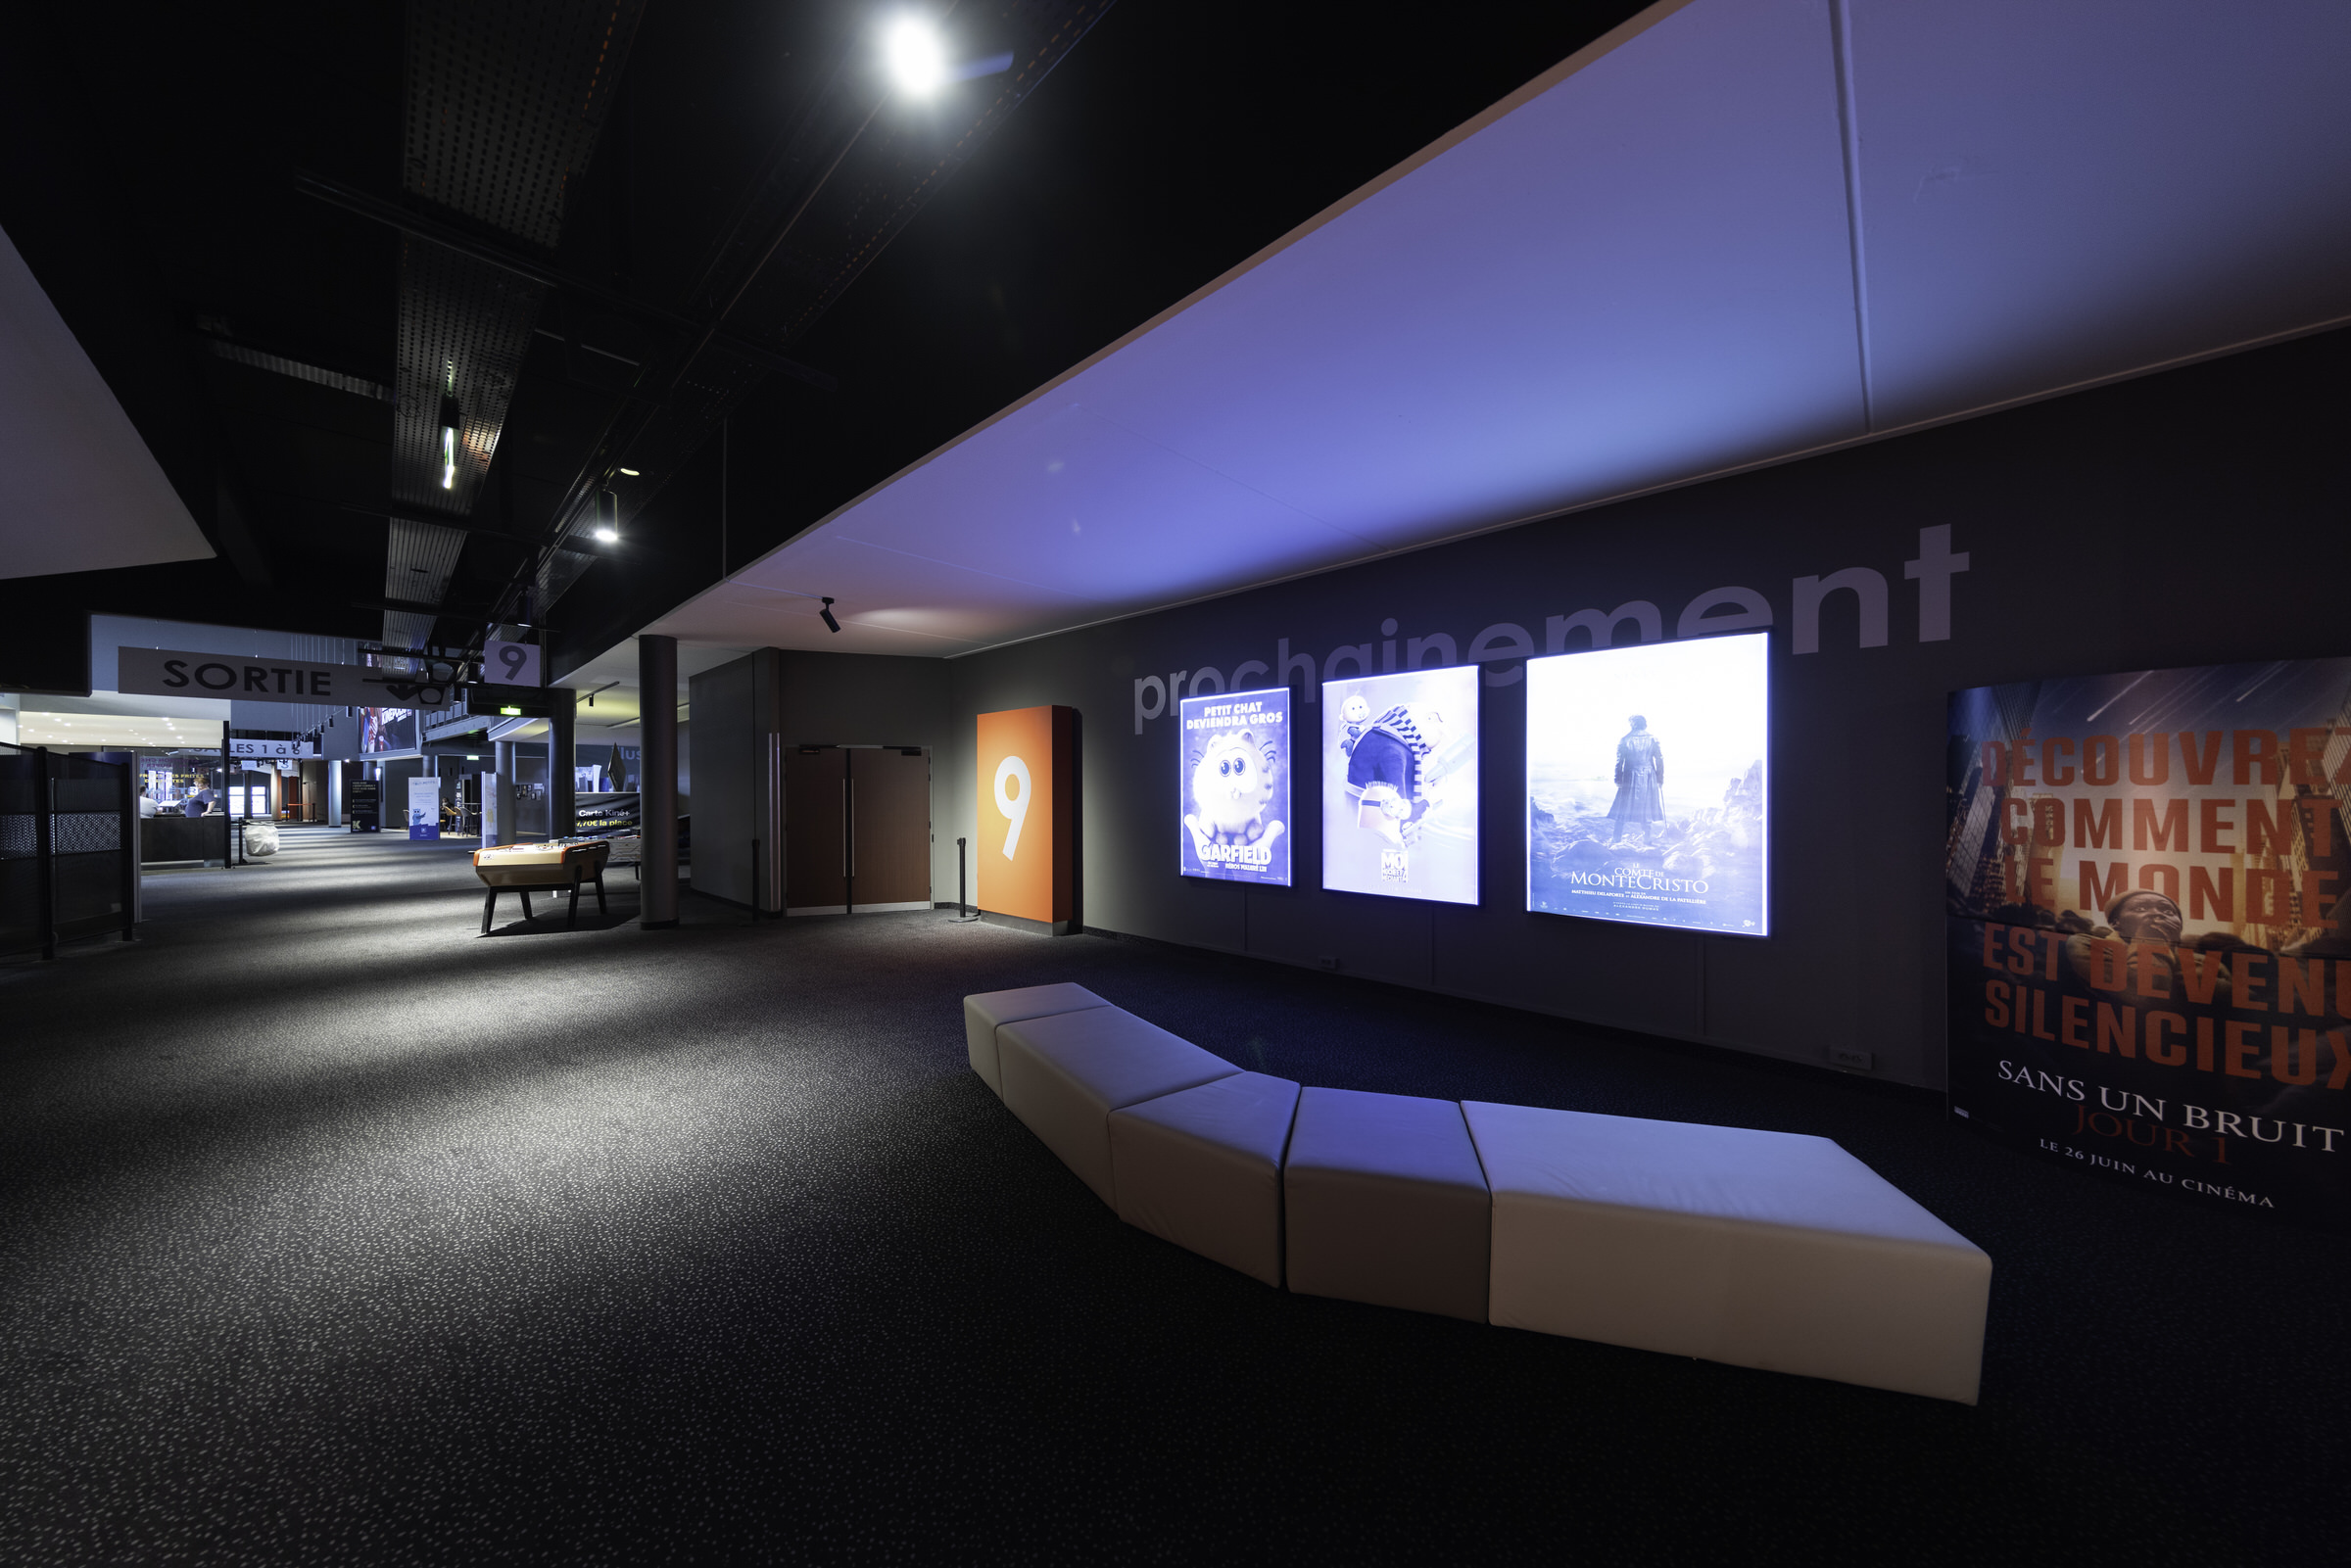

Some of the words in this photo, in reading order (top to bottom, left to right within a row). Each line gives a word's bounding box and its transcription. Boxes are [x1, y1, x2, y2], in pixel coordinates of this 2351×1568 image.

[162, 660, 332, 696] SORTIE
[499, 645, 527, 681] 9
[1186, 715, 1247, 730] DEVIENDRA
[1249, 711, 1283, 726] GROS
[1204, 704, 1232, 718] PETIT
[1233, 701, 1263, 715] CHAT
[263, 744, 267, 754] 1
[275, 744, 286, 754] à
[608, 819, 633, 828] place
[994, 755, 1032, 861] 9
[2000, 798, 2342, 857] COMMENT
[1198, 842, 1271, 866] GARFIELD
[1614, 867, 1655, 879] COMTE
[2003, 852, 2055, 909] LE
[2079, 861, 2339, 930] MONDE
[1983, 922, 2067, 981] EST
[1997, 1060, 2086, 1101] SANS
[2098, 1085, 2168, 1122] UN
[2182, 1104, 2344, 1153] BRUIT
[2072, 1104, 2196, 1158] JOUR
[2209, 1136, 2232, 1165] 1
[2039, 1138, 2059, 1152] LE
[2064, 1146, 2085, 1161] 26
[2089, 1154, 2136, 1175] JUIN
[2143, 1168, 2174, 1184] AU
[2181, 1178, 2276, 1209] CINÉMA
